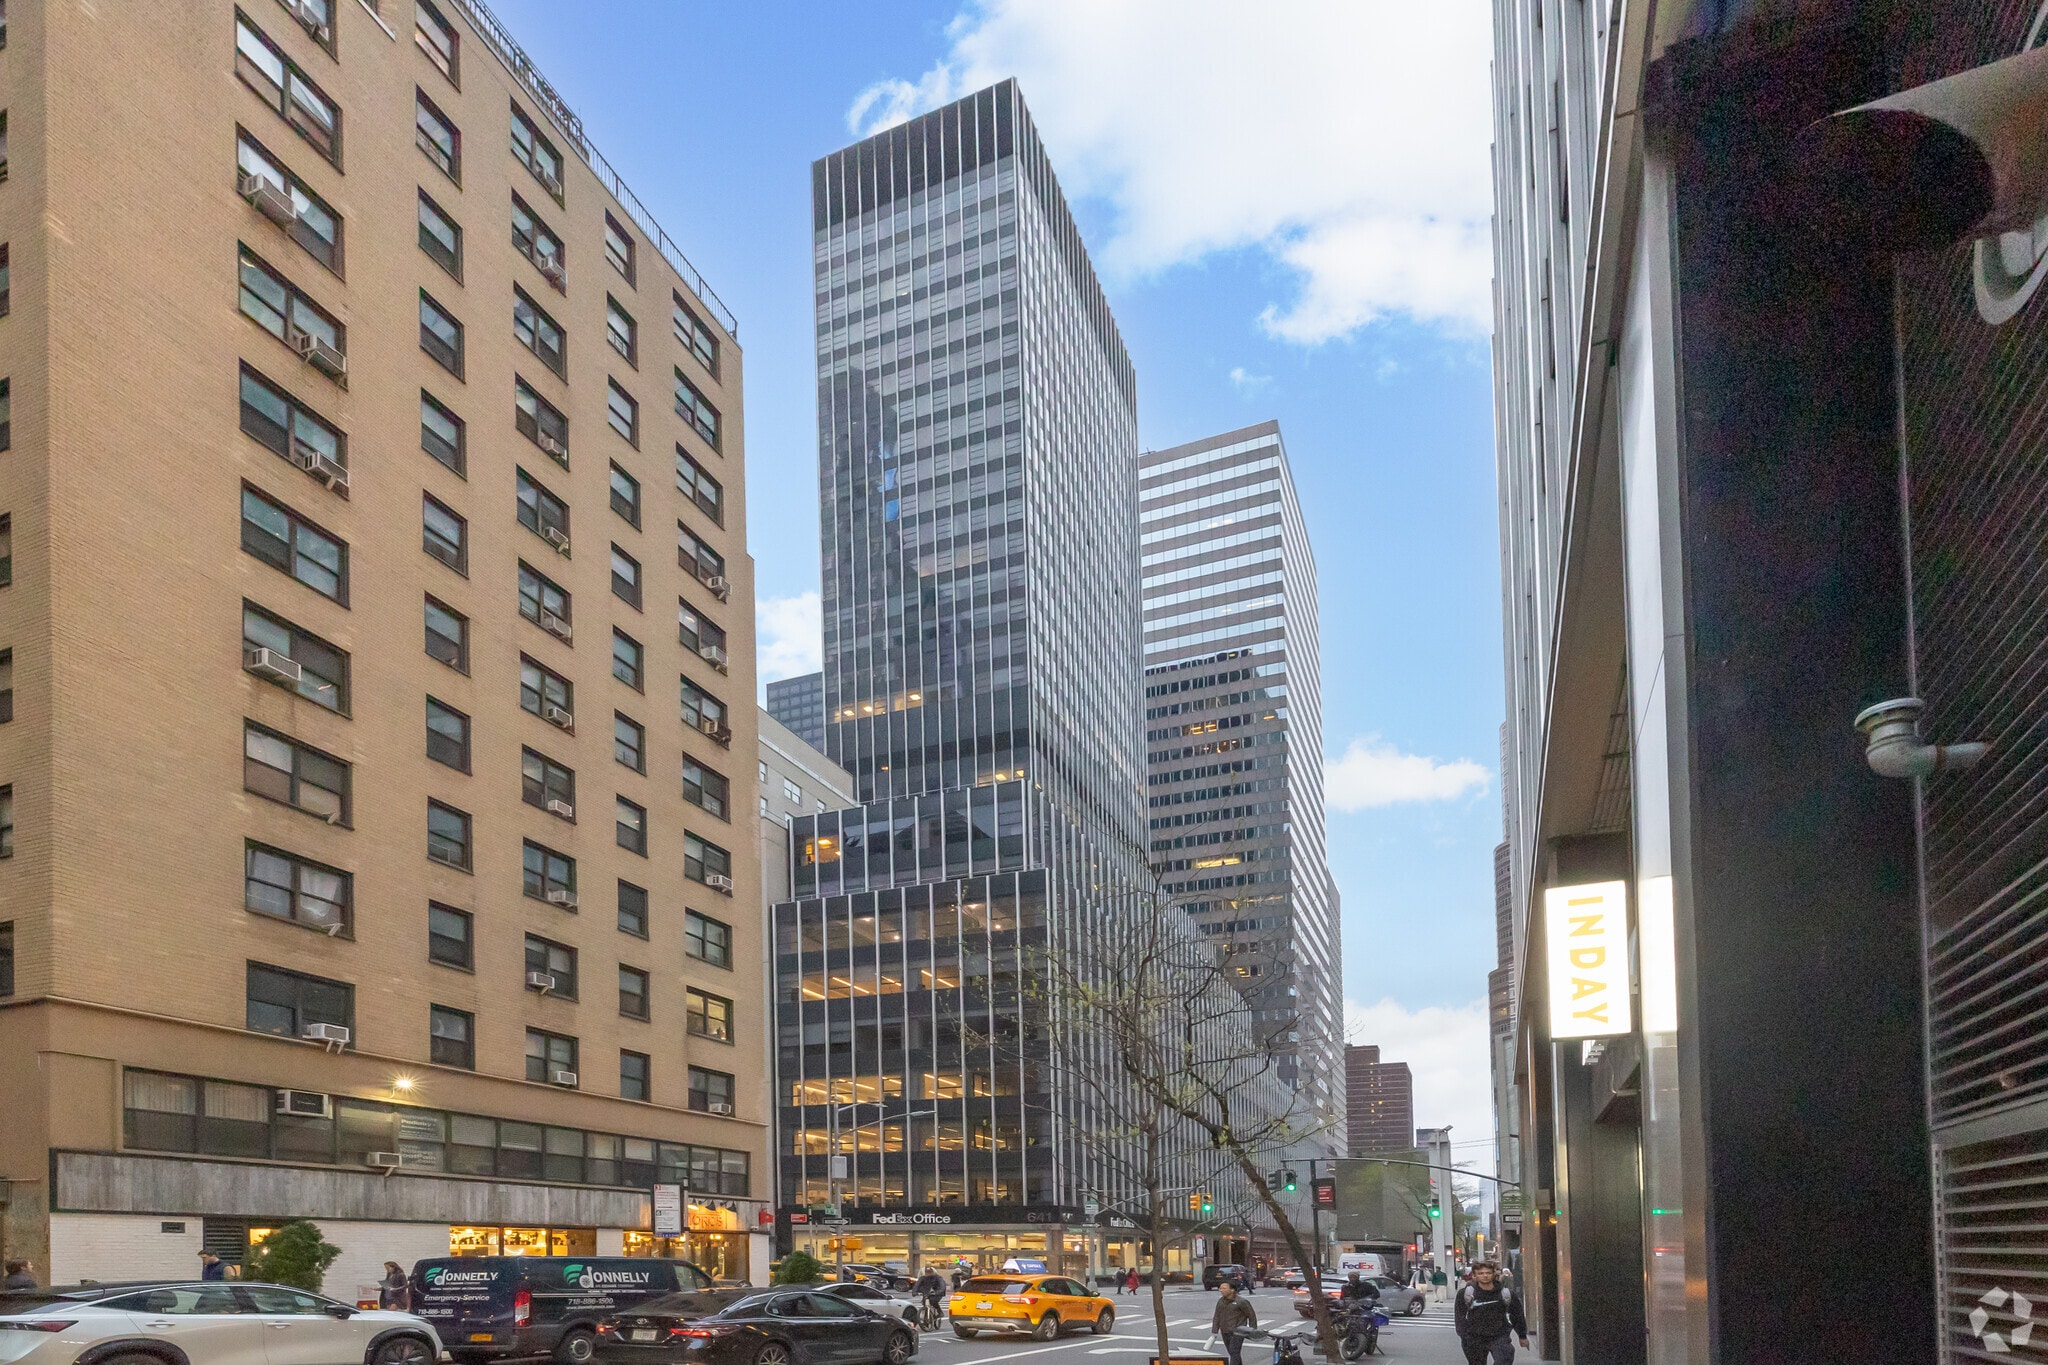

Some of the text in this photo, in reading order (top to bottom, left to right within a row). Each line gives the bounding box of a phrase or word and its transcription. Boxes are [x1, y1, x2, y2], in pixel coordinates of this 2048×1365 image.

[1567, 896, 1609, 1024] INDAY
[872, 1213, 951, 1224] FedEx Office
[1028, 1212, 1052, 1223] 641
[1342, 1262, 1374, 1270] FedEx
